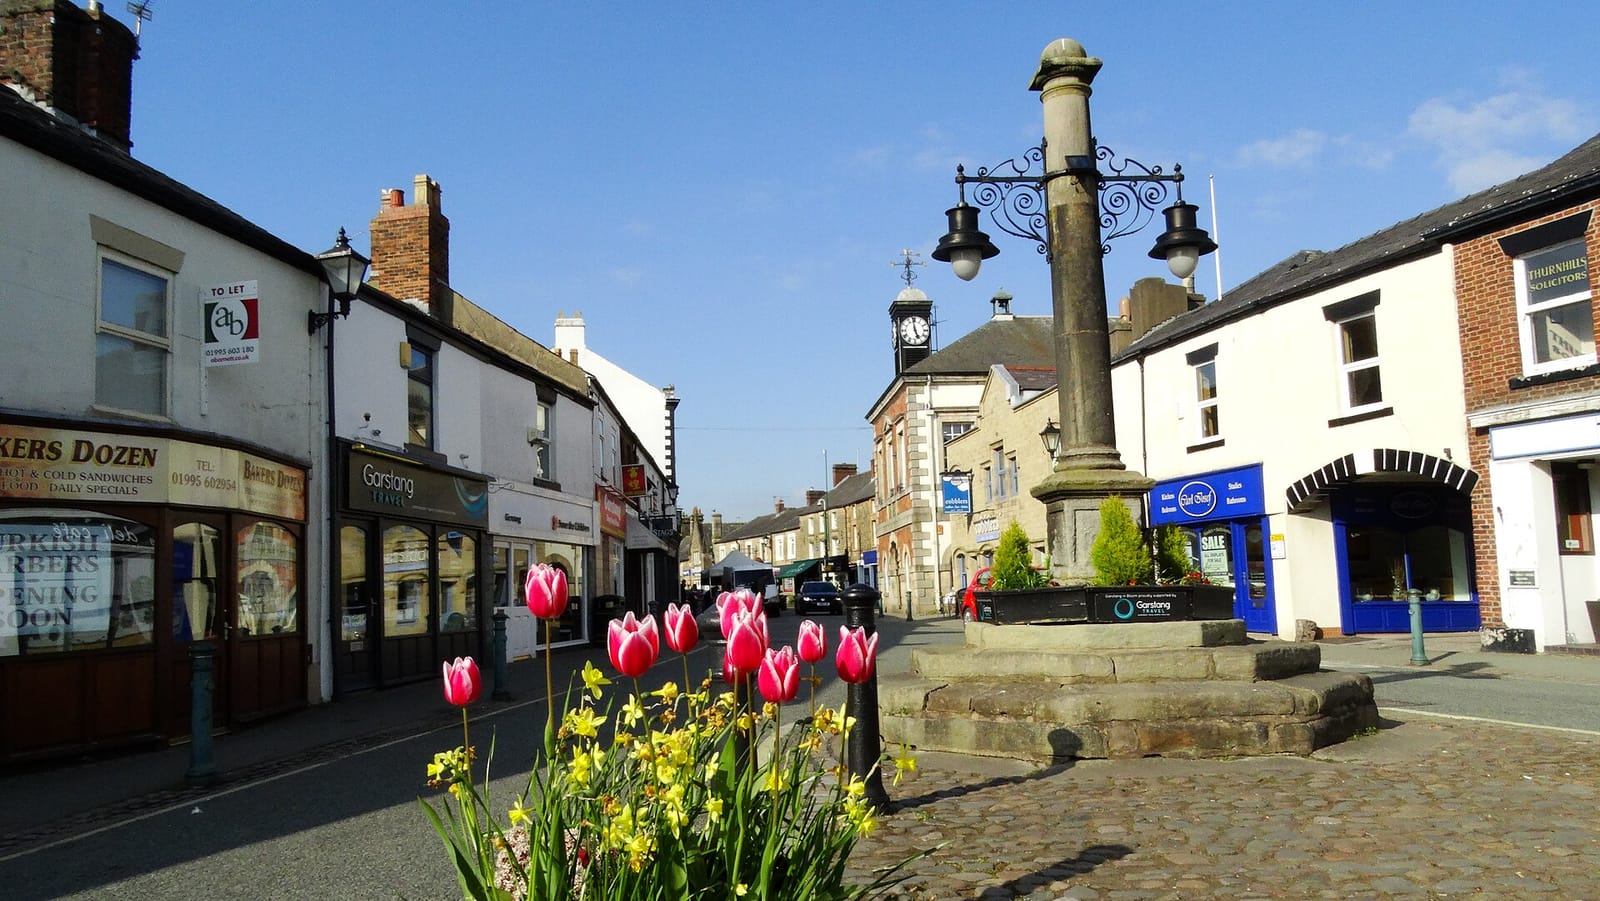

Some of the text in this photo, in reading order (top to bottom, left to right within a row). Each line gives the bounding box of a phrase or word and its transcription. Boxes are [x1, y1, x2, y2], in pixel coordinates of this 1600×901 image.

[1528, 257, 1587, 280] THURNHILLS
[1529, 271, 1588, 292] SOLICITORS
[211, 285, 245, 297] TO LET
[206, 348, 226, 357] 01995
[71, 439, 158, 466] DOZEN
[31, 469, 39, 479] &
[43, 470, 76, 480] COLD
[79, 471, 153, 485] SANDWICHES
[172, 472, 237, 492] 01995 602954
[363, 463, 414, 499] Garstang
[2, 480, 139, 496] FOOD DAILY SPECIALS
[371, 491, 405, 508] TRAVEL
[1201, 535, 1226, 550] SALE
[0, 555, 100, 573] RBERS
[1136, 600, 1171, 610] Garstang
